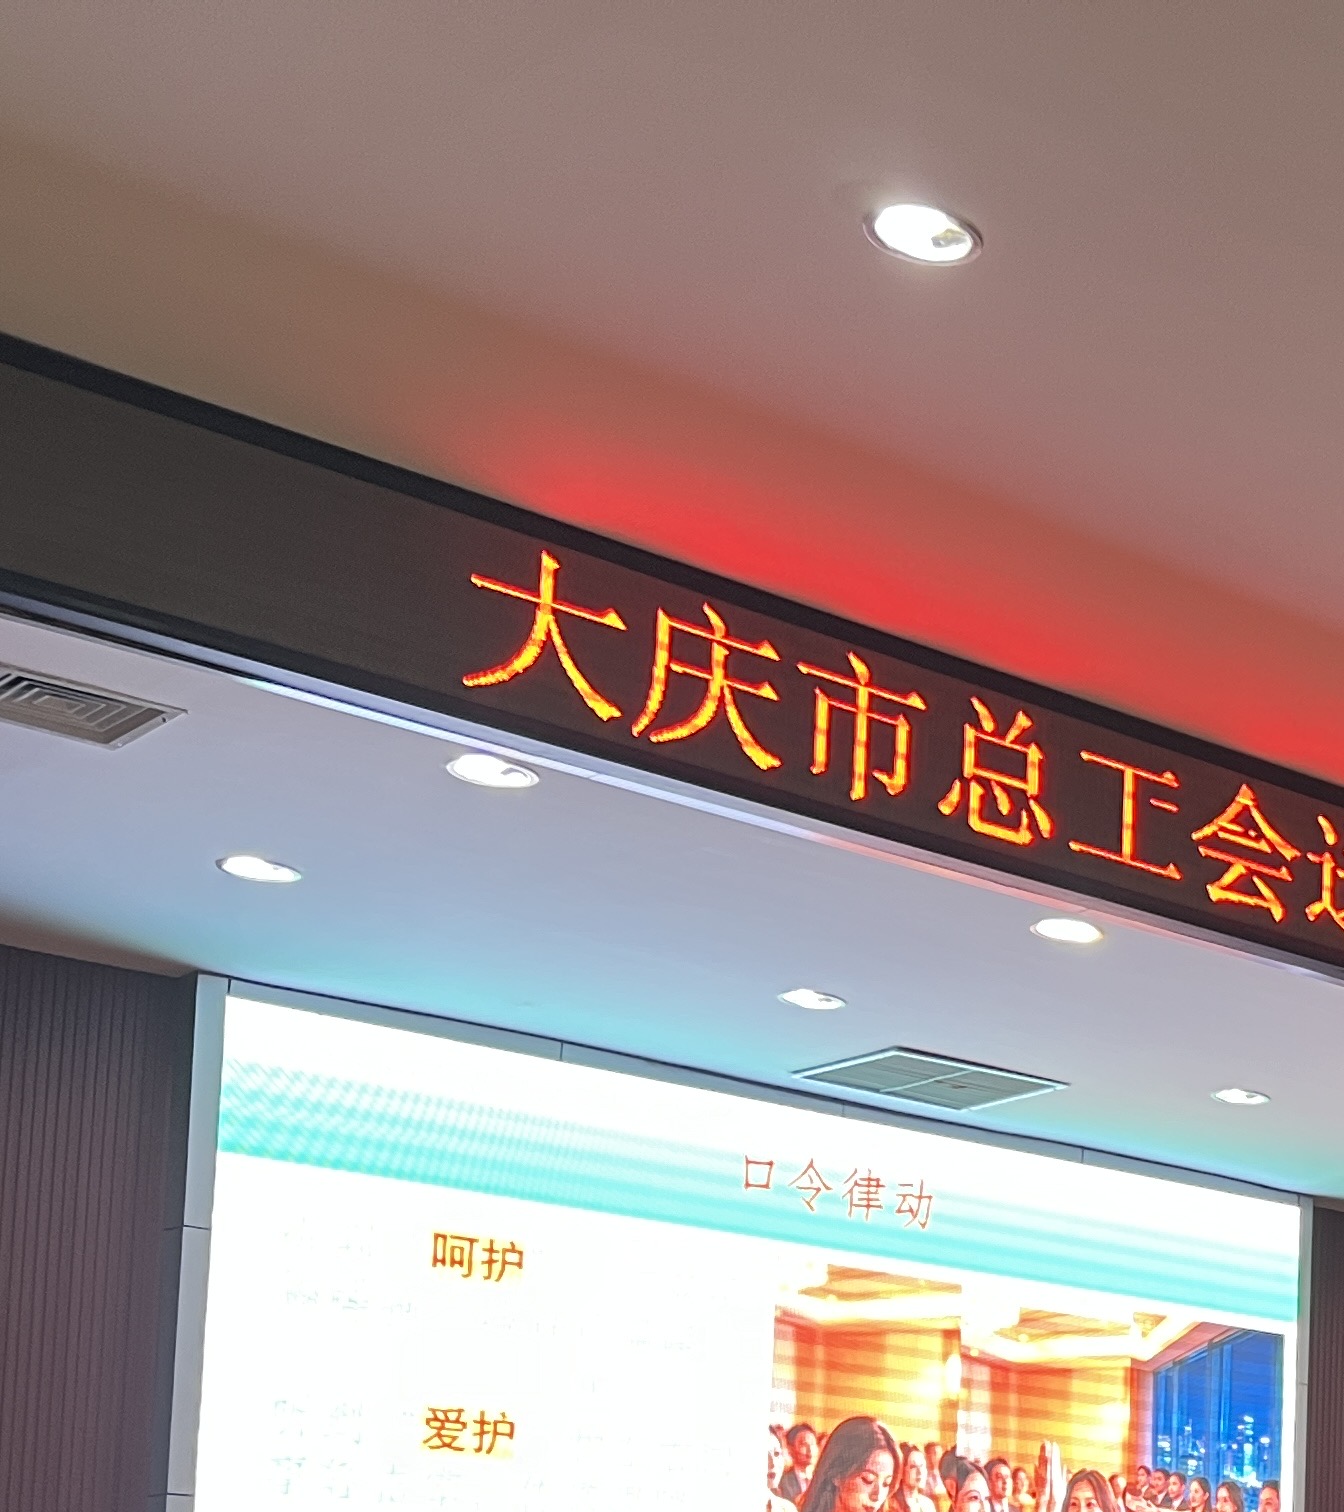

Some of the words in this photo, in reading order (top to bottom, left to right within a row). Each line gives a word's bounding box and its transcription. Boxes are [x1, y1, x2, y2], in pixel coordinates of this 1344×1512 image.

[743, 1154, 933, 1230] 口令律动
[431, 1232, 524, 1282] 呵护
[422, 1406, 516, 1455] 爱护
